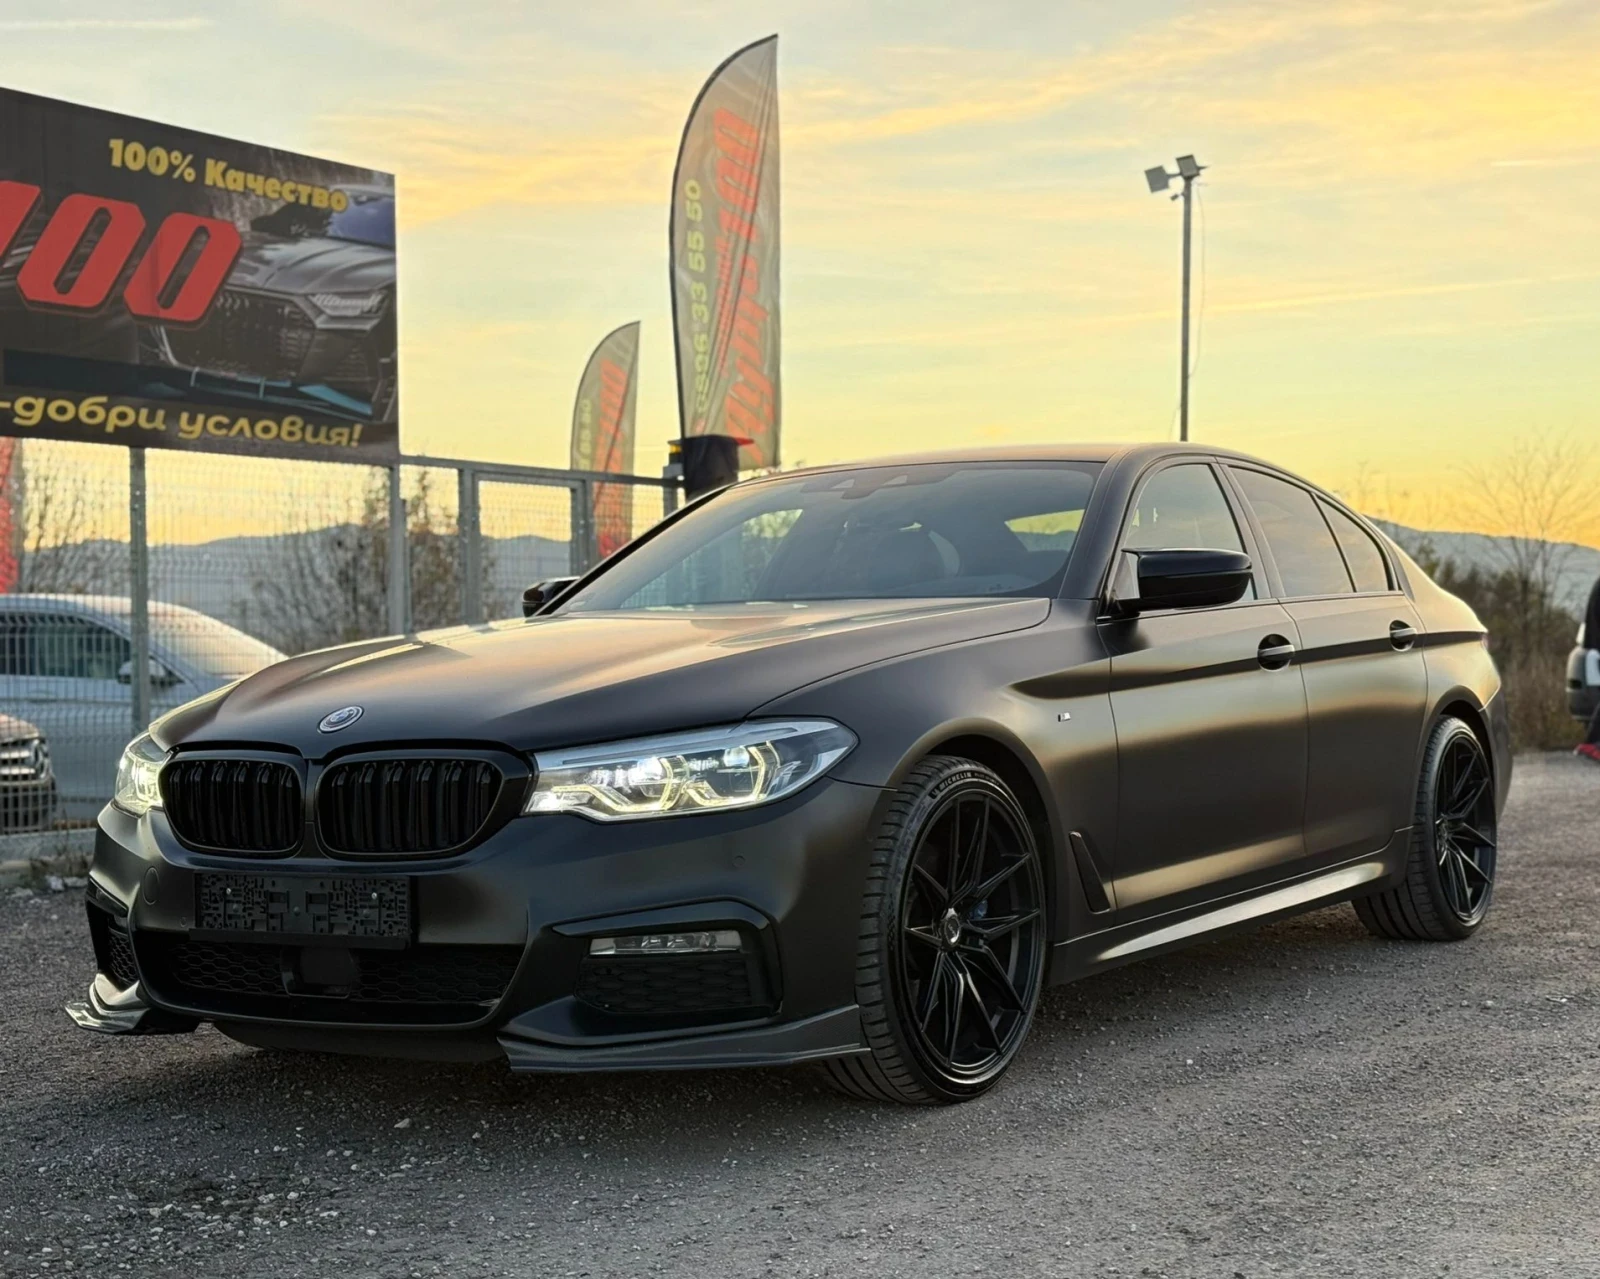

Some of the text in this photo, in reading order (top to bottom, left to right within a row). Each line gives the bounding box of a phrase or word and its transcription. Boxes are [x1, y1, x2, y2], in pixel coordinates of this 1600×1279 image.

[109, 139, 348, 213] 100% Качество
[684, 179, 704, 222] 50
[687, 231, 707, 273] 55
[691, 280, 710, 324] 33
[178, 415, 362, 447] условия!
[939, 771, 972, 790] MICHELIN
